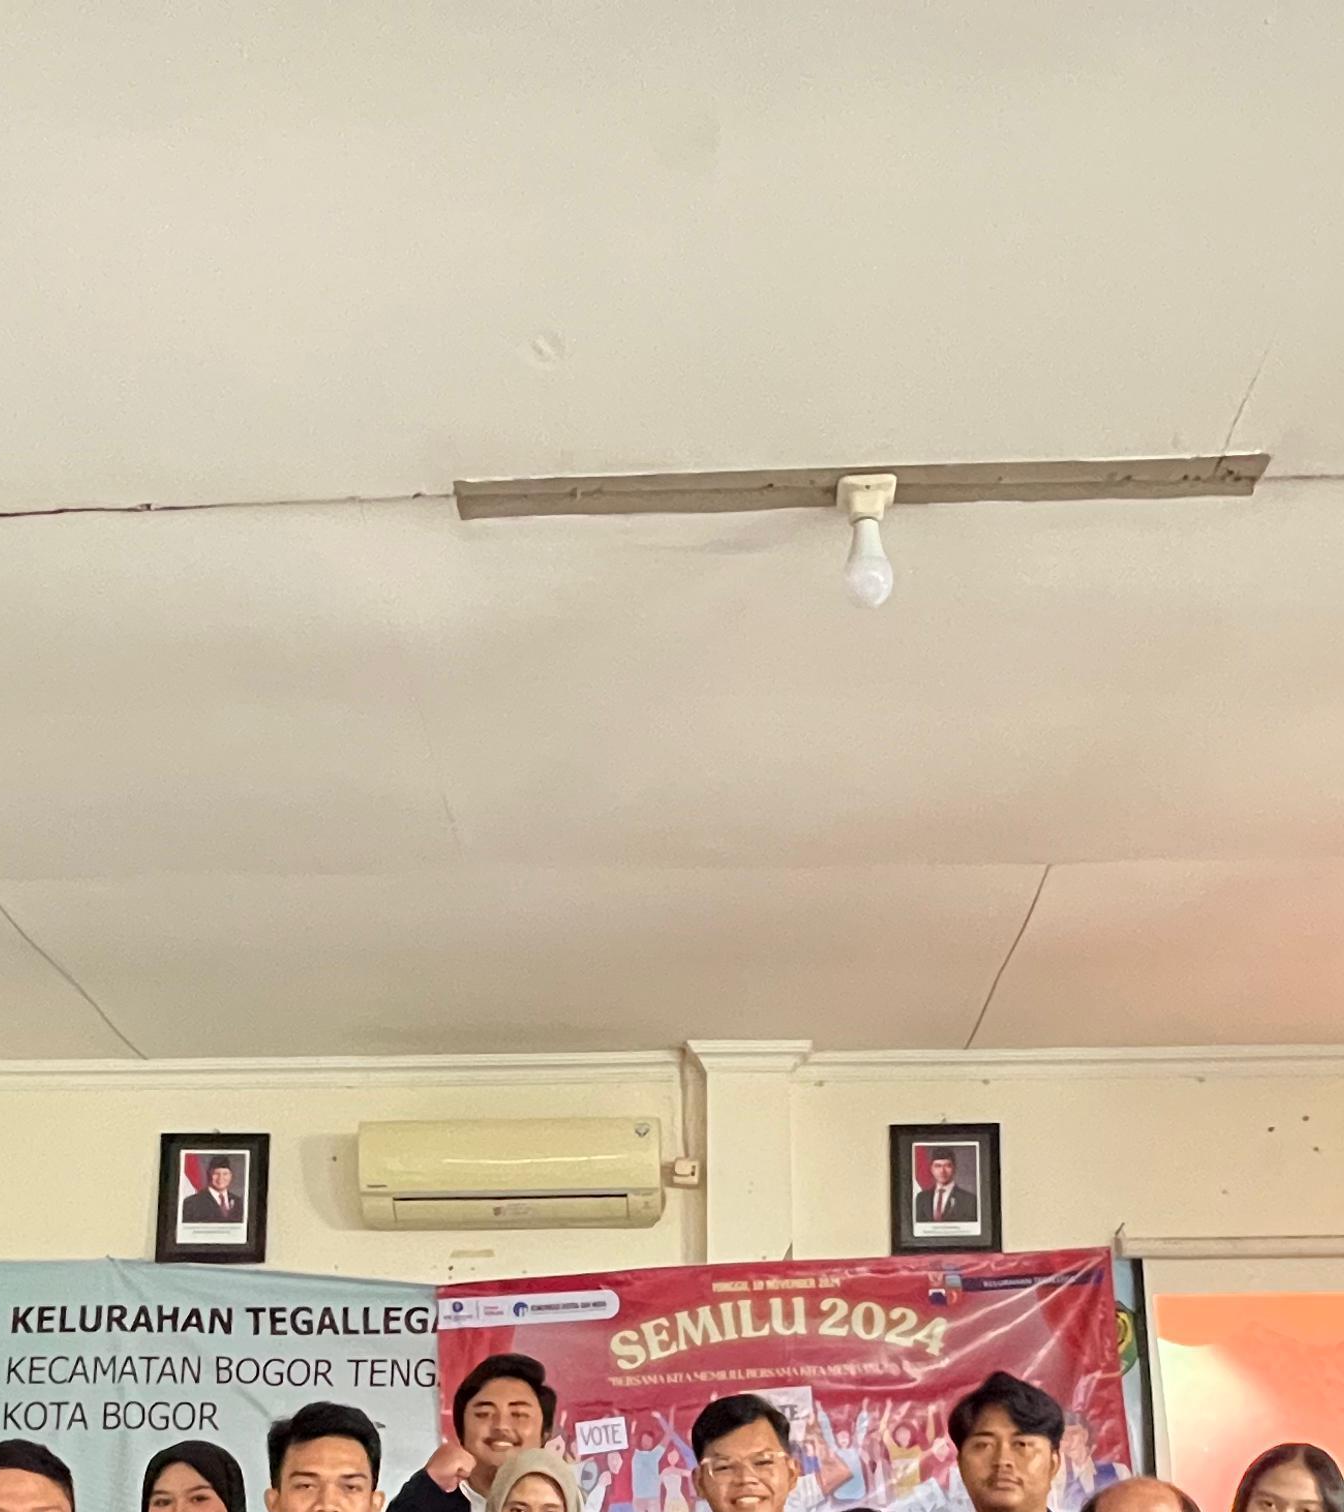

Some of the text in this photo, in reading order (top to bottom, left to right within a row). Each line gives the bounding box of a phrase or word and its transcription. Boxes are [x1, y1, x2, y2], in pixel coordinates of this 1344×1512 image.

[11, 1303, 233, 1335] KELURAHAN
[609, 1296, 949, 1371] SEMILU 2024
[6, 1355, 441, 1388] KECAMATAN BOGOR TENG
[2, 1400, 220, 1432] KOTA BOGOR
[579, 1422, 623, 1447] VOTE
